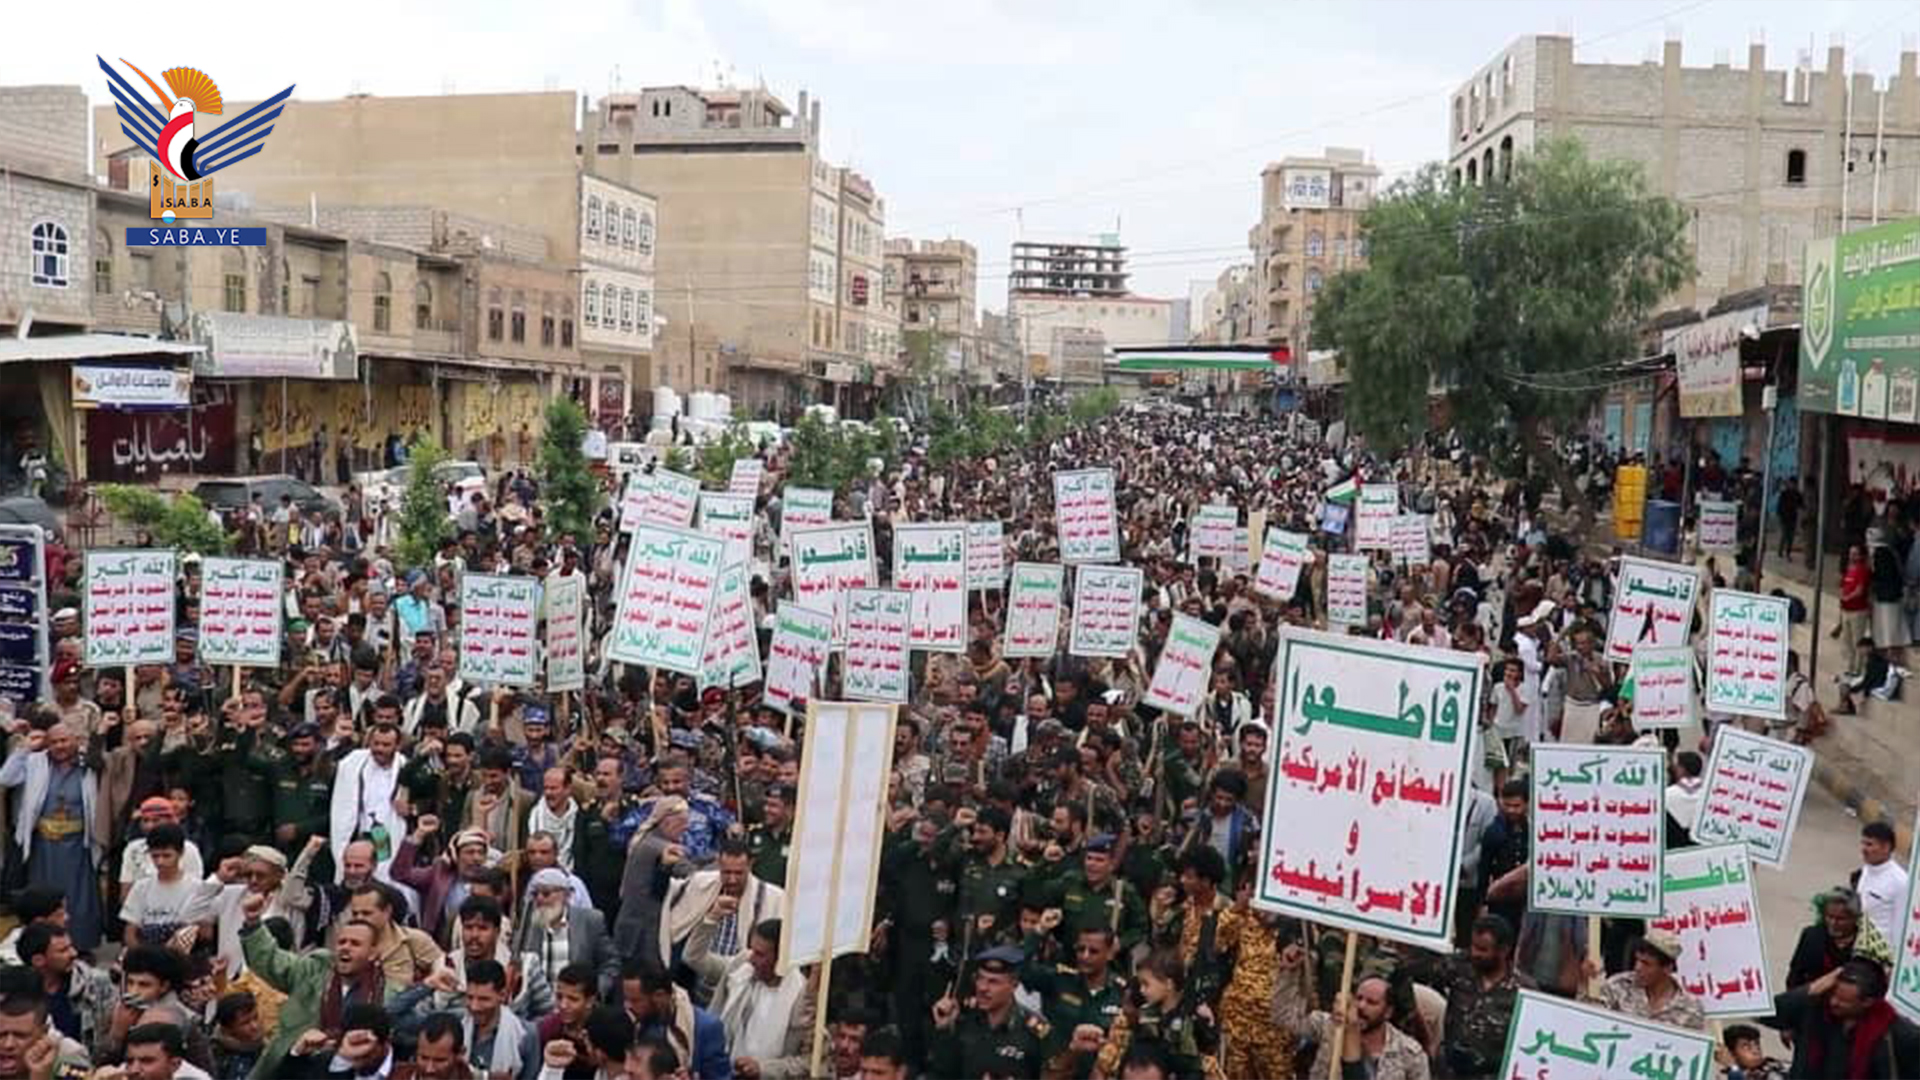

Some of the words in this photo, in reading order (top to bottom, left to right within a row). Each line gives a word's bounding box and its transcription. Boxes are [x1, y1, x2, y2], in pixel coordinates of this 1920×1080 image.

[901, 534, 961, 569] قاطعوا
[1291, 666, 1461, 743] قاطعوا
[1281, 741, 1367, 793] الأمريكية
[1373, 757, 1454, 814] البضائع
[1539, 755, 1609, 791] أكبر
[1613, 759, 1658, 785] الله
[1346, 820, 1359, 855] و
[1271, 849, 1441, 925] الإسرائيلية
[1536, 876, 1596, 907] للإسلام
[1603, 878, 1657, 908] النصر
[1520, 1024, 1632, 1070] أكبر
[1629, 1042, 1699, 1080] الله
